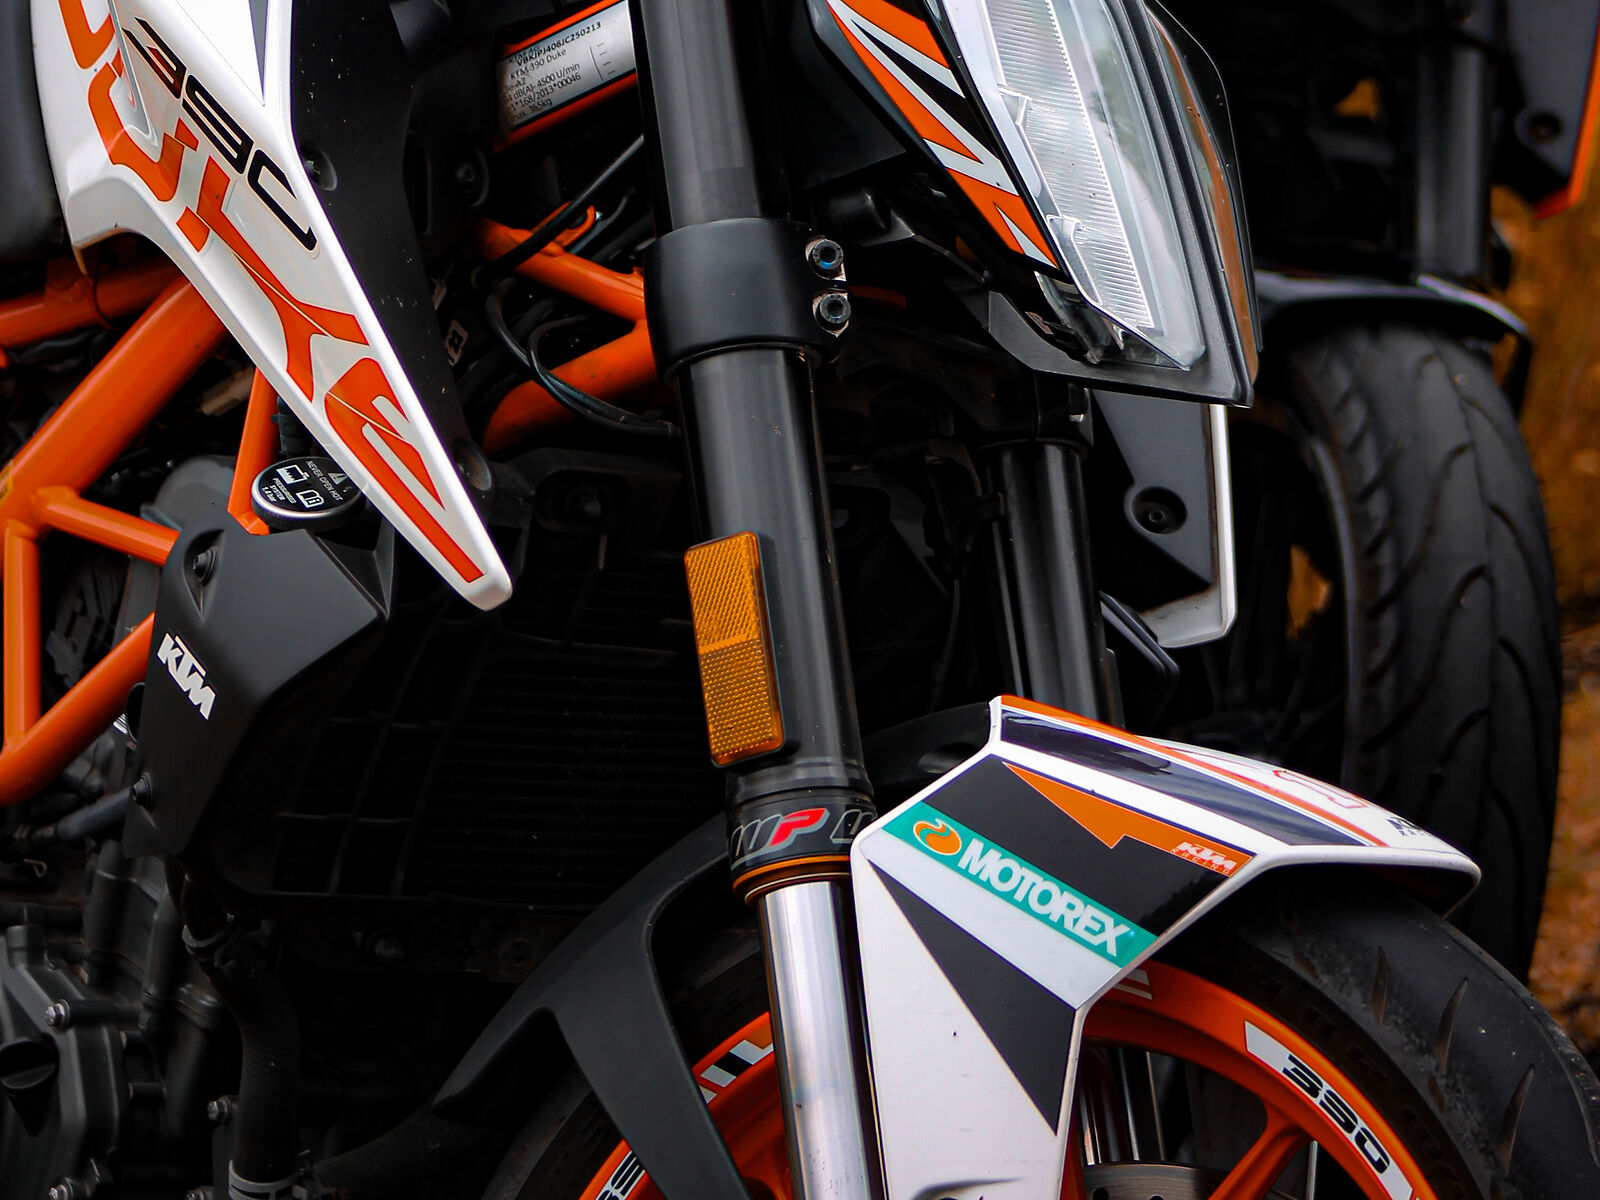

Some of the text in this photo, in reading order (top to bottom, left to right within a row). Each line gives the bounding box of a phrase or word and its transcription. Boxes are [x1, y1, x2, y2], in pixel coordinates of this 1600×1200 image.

[510, 48, 567, 80] KTM 390 Duke
[537, 72, 556, 87] 4500
[556, 62, 580, 79] U/min
[121, 16, 319, 252] 390
[305, 460, 344, 501] NEVER OPEN HOT
[157, 632, 216, 721] KTM
[1175, 841, 1237, 870] KTM
[957, 838, 1130, 957] MOTOREX
[1281, 1053, 1391, 1175] 390
